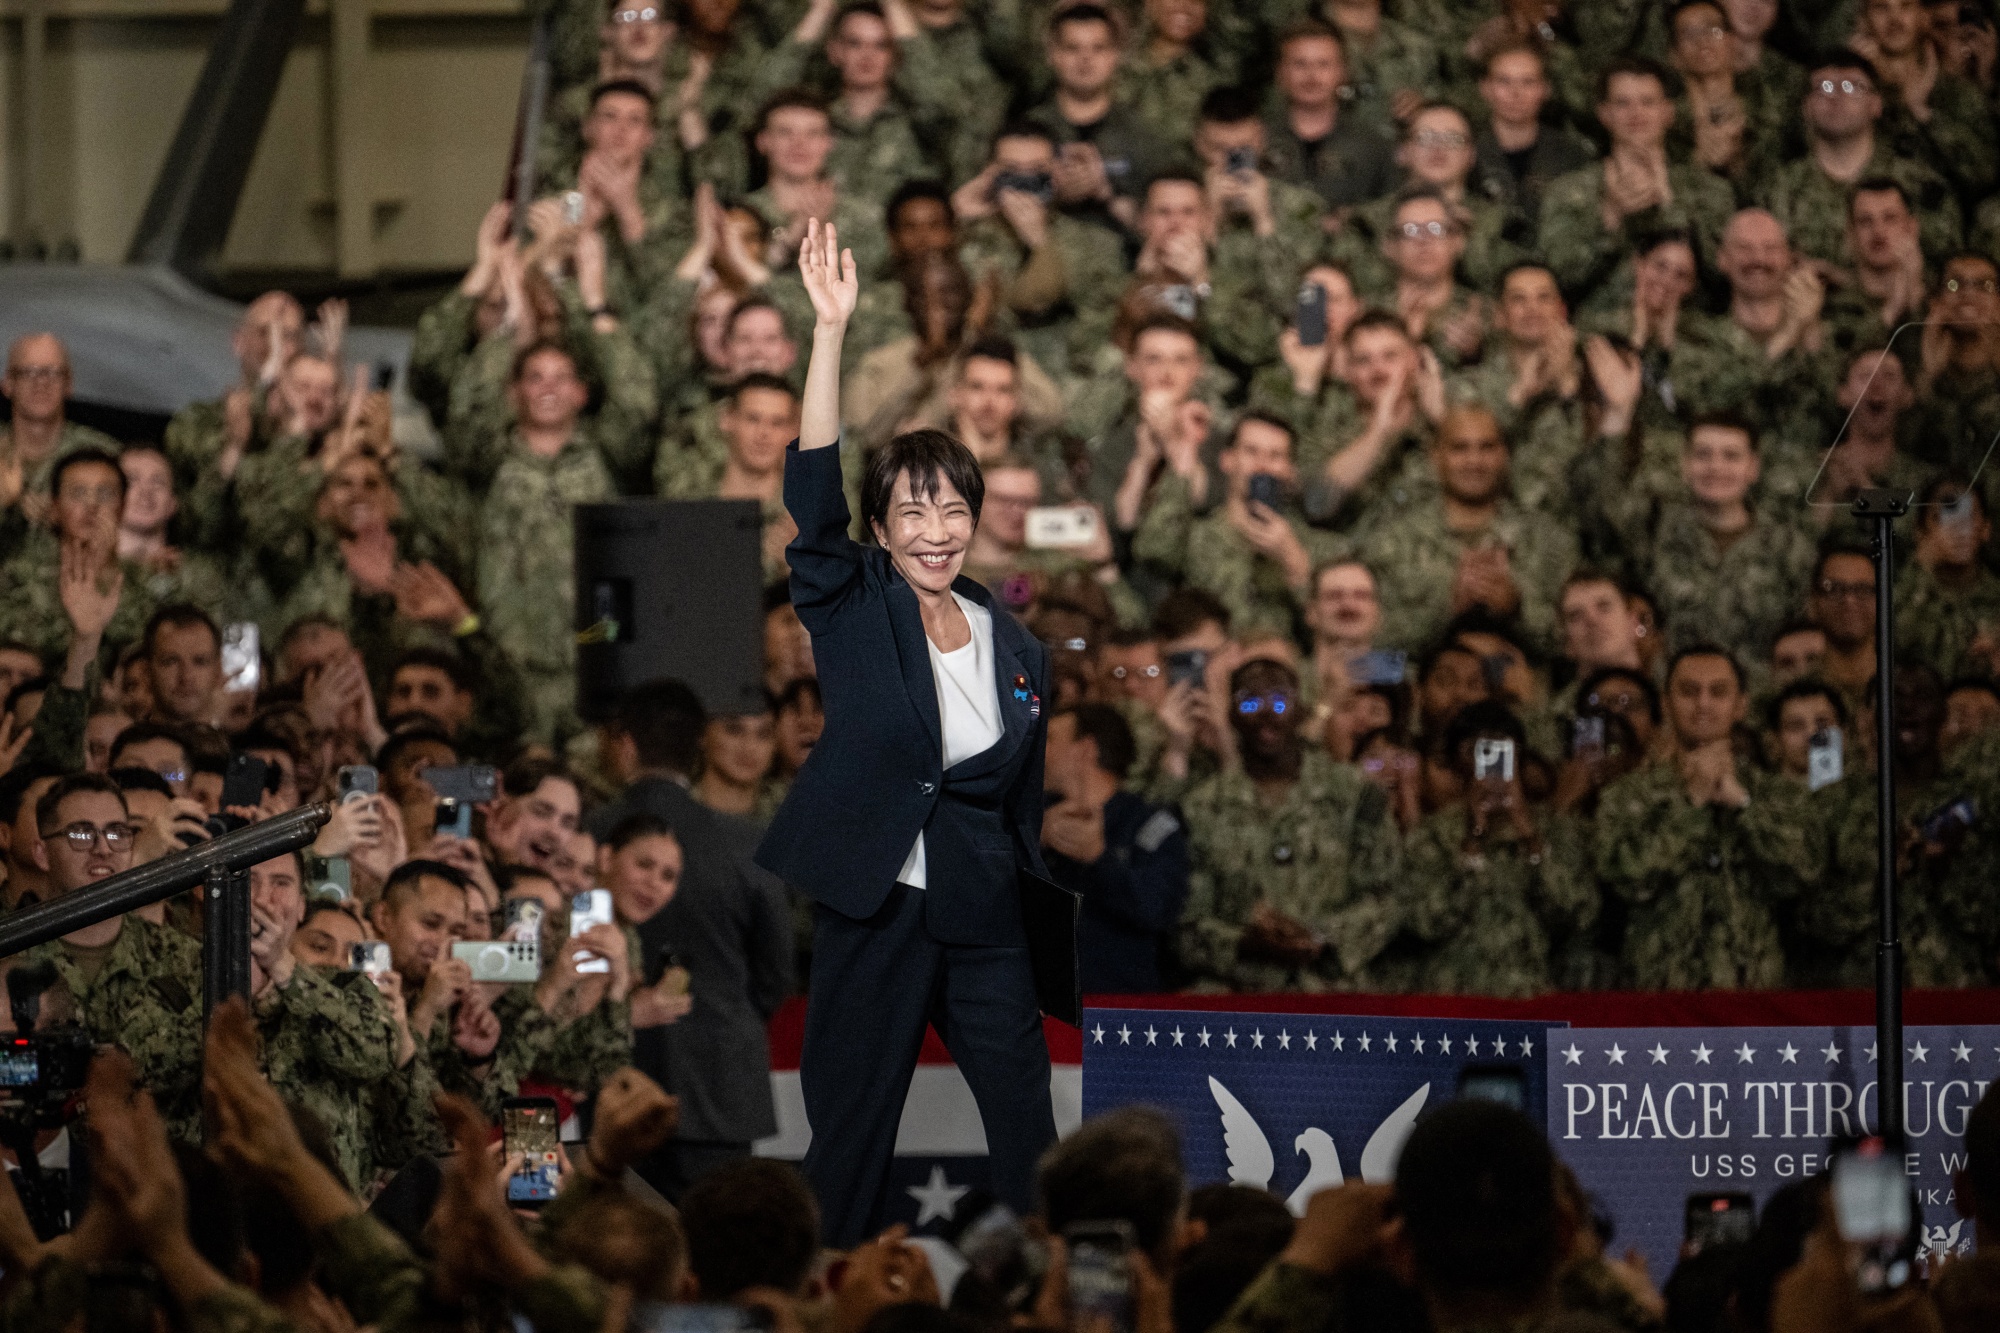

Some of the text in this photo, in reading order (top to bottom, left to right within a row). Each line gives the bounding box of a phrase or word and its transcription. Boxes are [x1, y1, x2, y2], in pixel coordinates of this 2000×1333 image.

[1562, 1080, 1990, 1140] PEACE THROUG
[1691, 1153, 1757, 1178] USS
